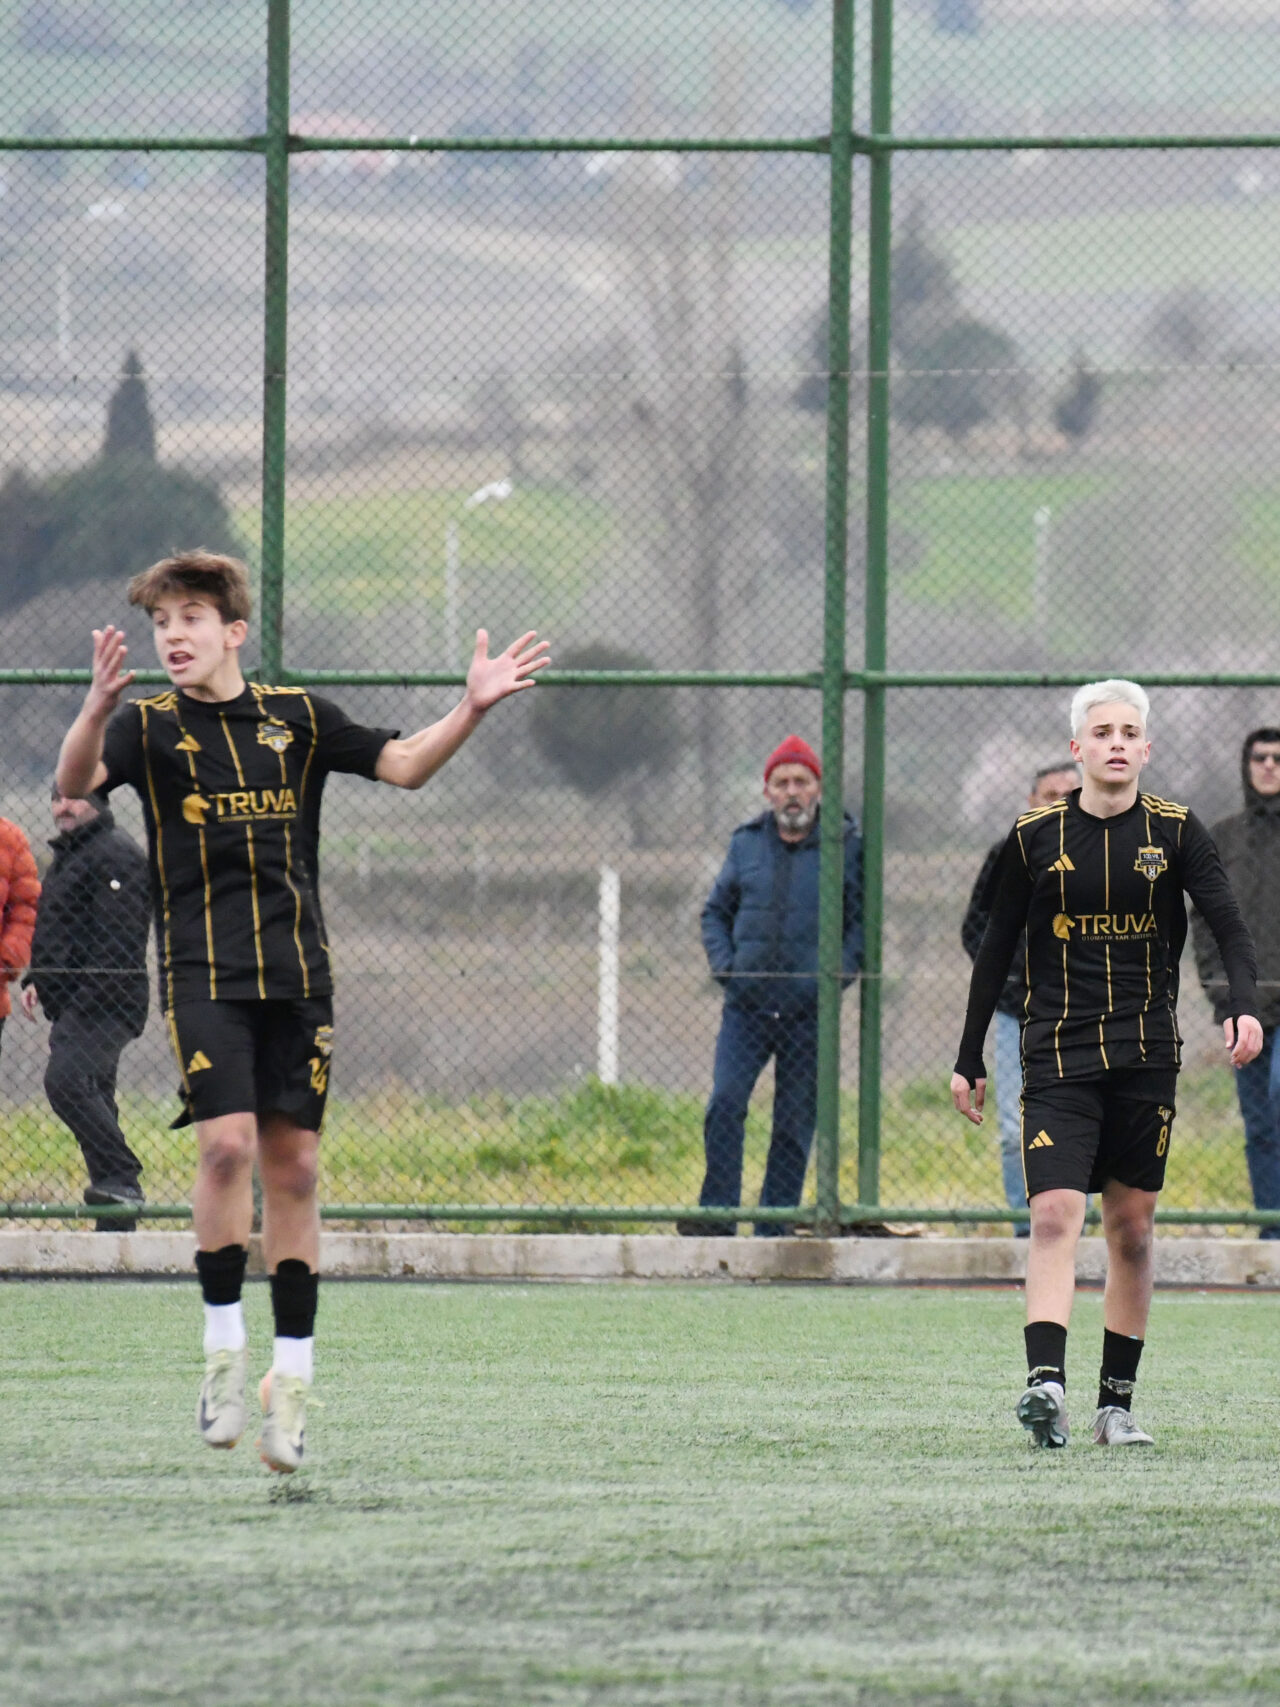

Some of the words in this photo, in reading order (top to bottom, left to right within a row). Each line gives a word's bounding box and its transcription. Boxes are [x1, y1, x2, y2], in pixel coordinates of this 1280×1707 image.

[208, 788, 297, 815] TRUVA
[1075, 913, 1158, 935] TRUVA
[1156, 1125, 1168, 1157] 8
